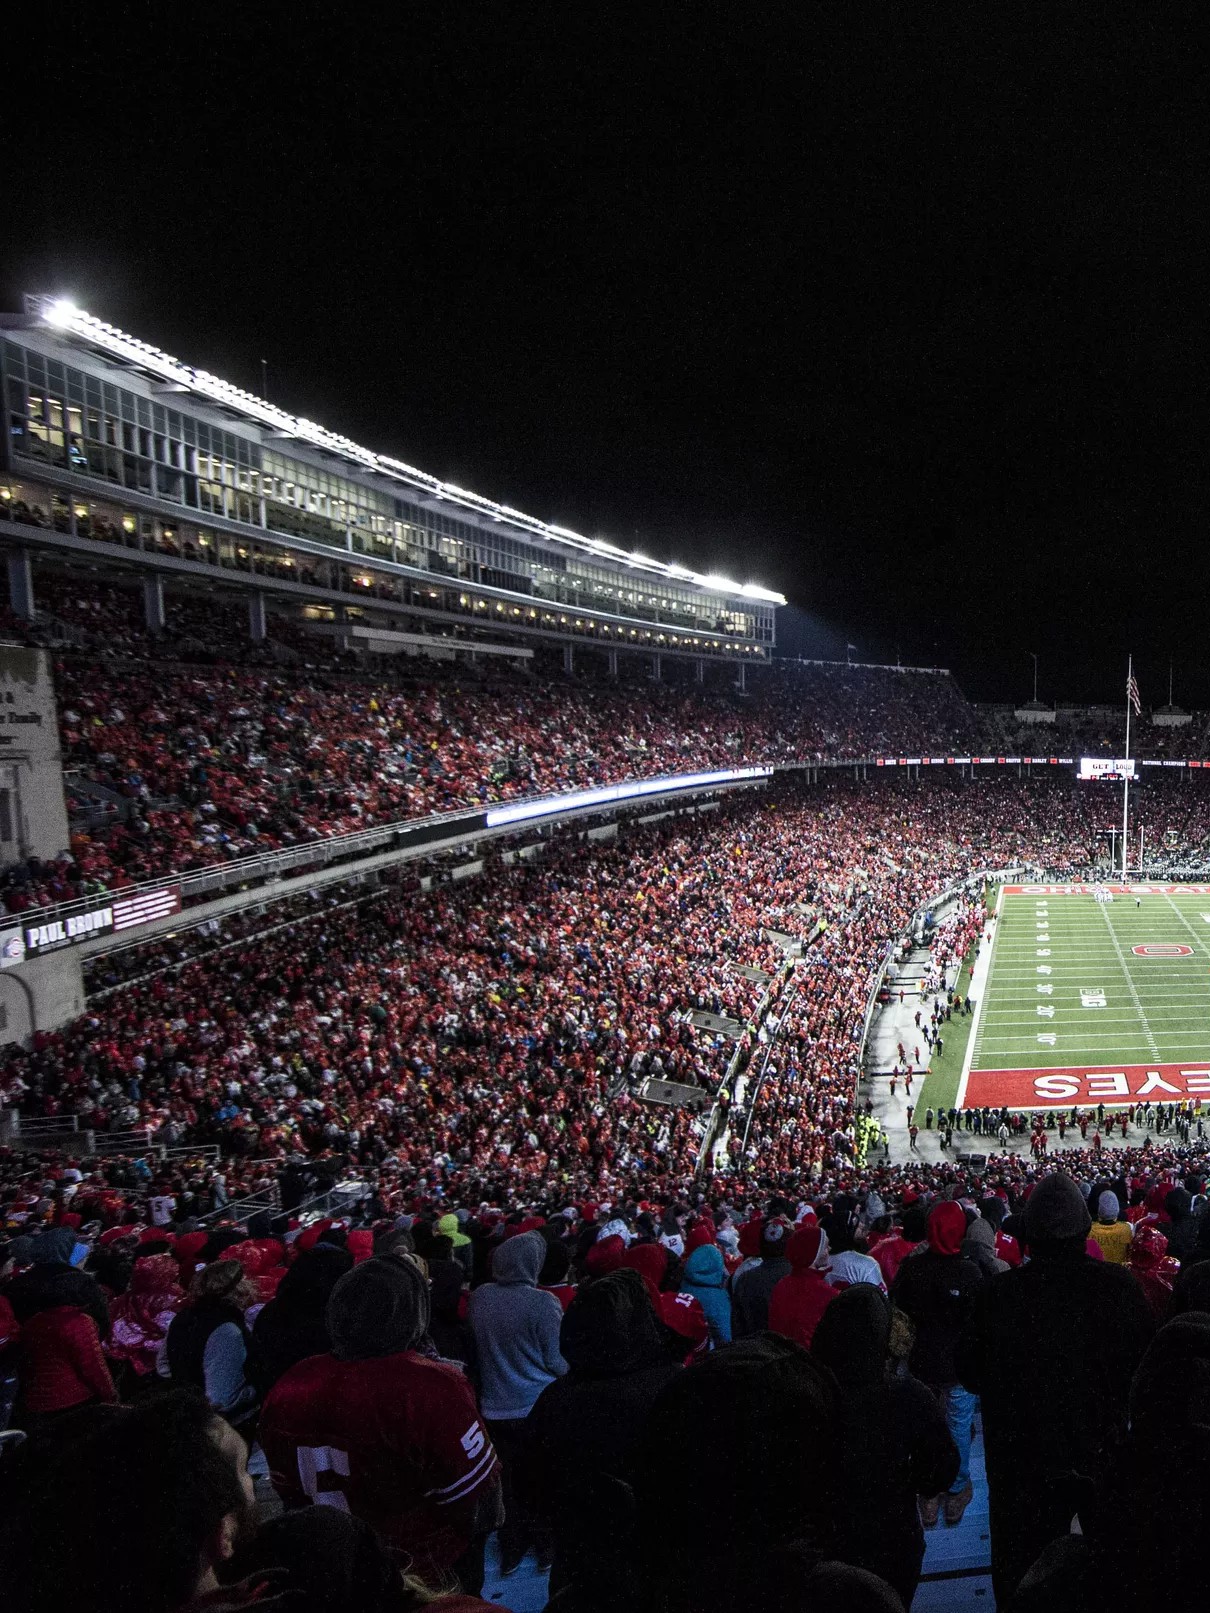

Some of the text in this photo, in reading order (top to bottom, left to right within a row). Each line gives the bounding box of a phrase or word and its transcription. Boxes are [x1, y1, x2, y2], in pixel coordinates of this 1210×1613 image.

[27, 921, 66, 948] PAUL
[65, 907, 113, 937] BROWN
[460, 1420, 485, 1460] 5
